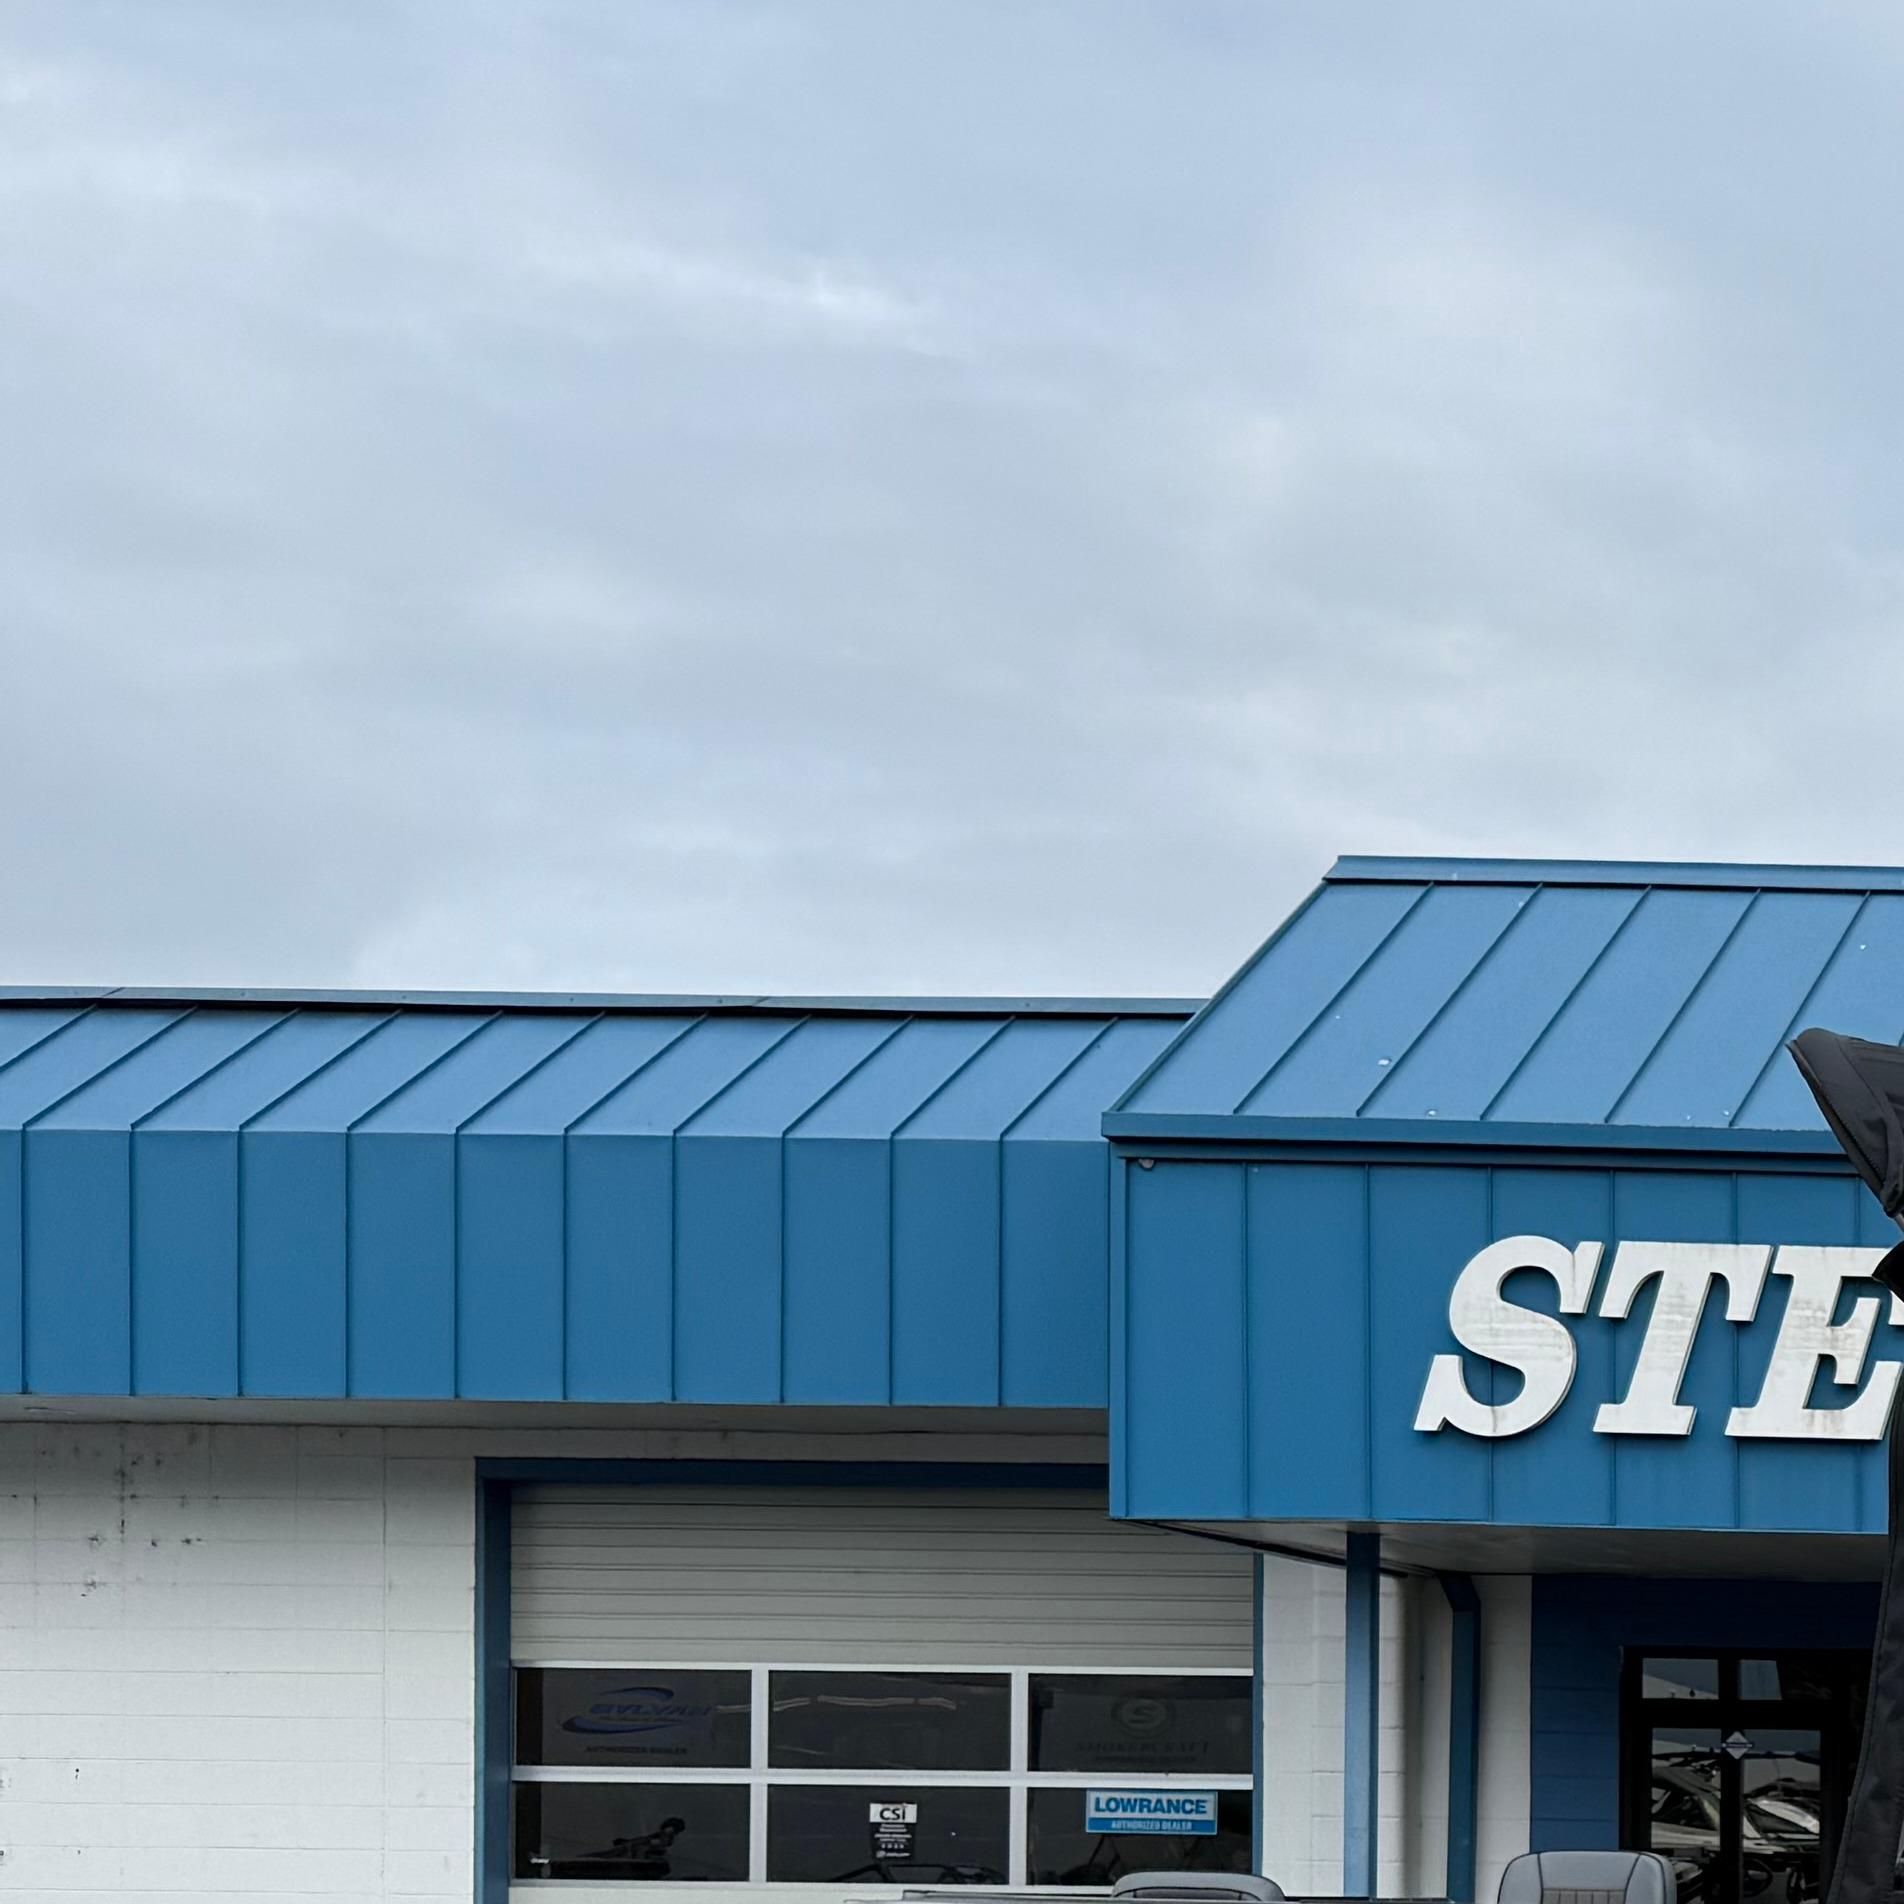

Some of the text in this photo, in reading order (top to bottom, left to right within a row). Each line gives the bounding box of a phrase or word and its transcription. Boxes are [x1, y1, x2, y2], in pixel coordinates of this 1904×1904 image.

[1094, 1796, 1207, 1814] LOWRANCE
[1111, 1820, 1193, 1831] AUTHORIZED DEALER
